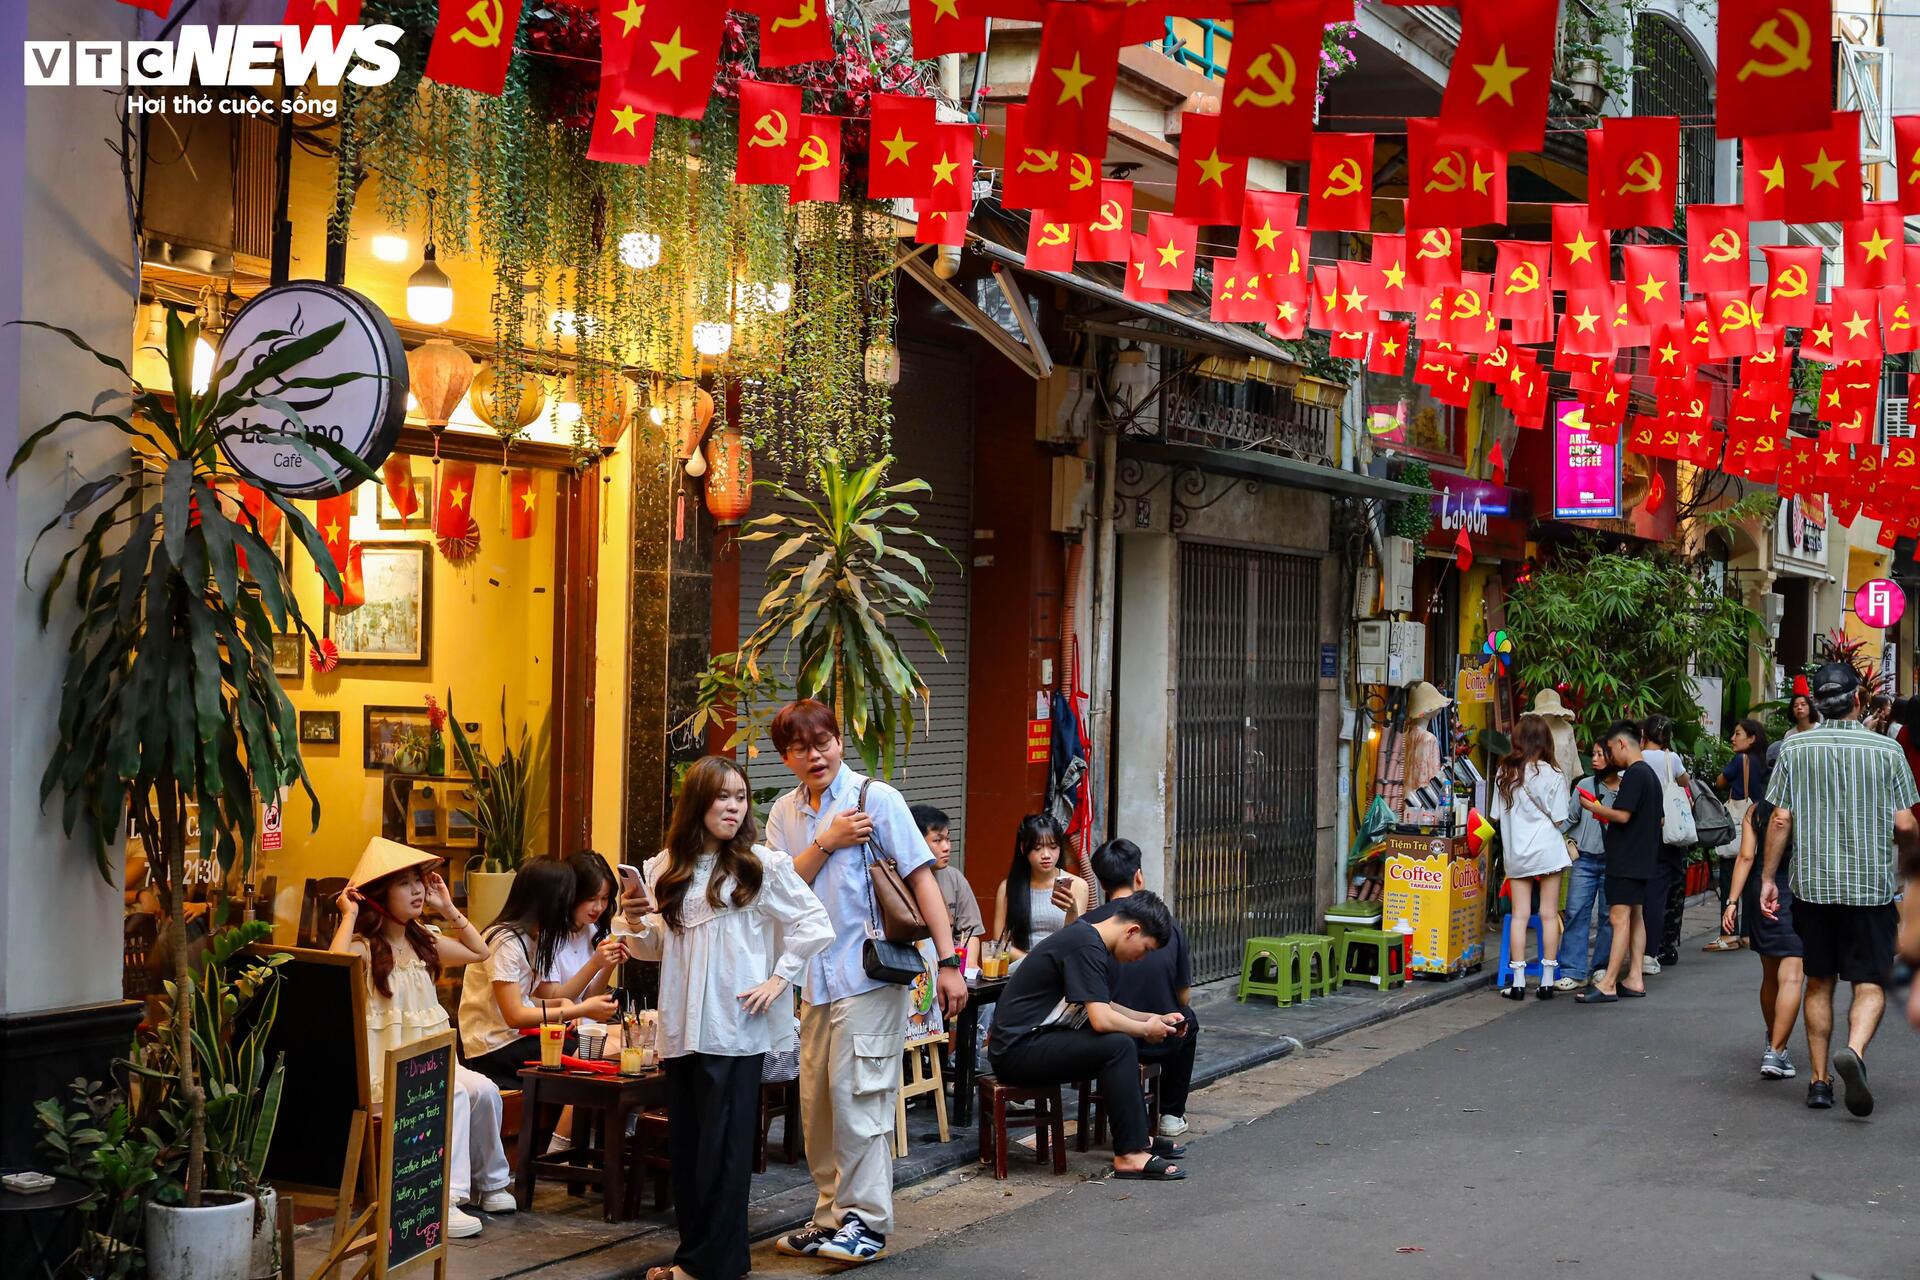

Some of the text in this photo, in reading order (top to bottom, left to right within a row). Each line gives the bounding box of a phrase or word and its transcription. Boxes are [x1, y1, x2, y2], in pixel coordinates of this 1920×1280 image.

[1390, 838, 1412, 850] Tiệm
[182, 858, 221, 885] 21:30
[1389, 864, 1442, 883] Coffee
[1410, 882, 1442, 890] TAKEAWAY
[406, 1081, 436, 1107] Sandwich
